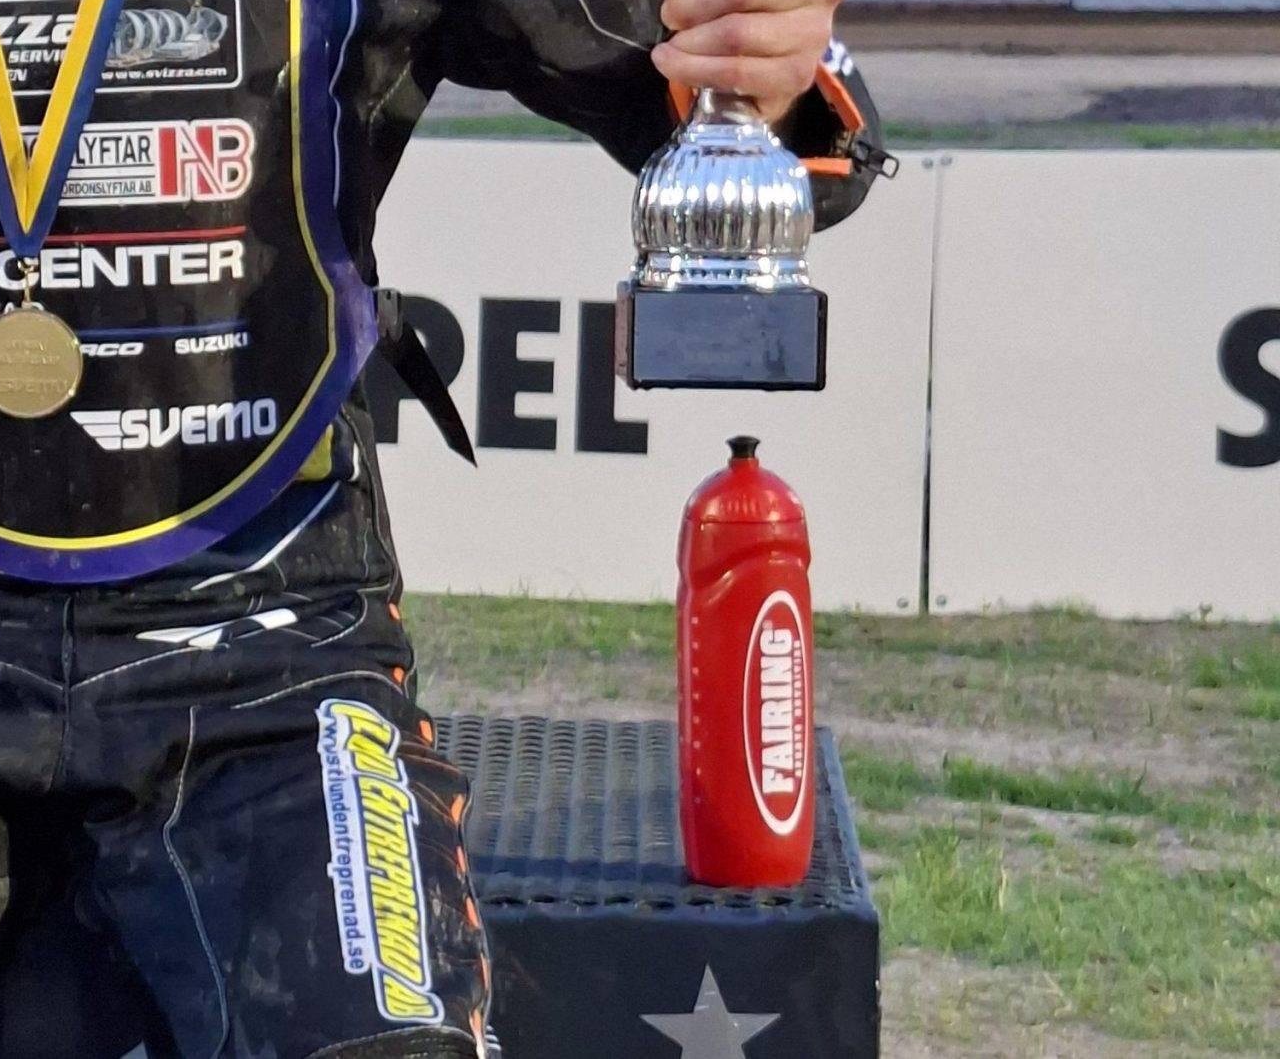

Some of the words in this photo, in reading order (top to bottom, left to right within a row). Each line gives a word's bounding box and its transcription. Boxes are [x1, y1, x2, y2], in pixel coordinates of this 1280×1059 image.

[63, 180, 134, 195] ORDONSLYFTAR
[138, 180, 152, 193] AB
[174, 332, 248, 354] SUZUKI
[375, 294, 649, 454] PEL
[760, 628, 794, 794] FAIRING
[383, 973, 436, 1017] AB
